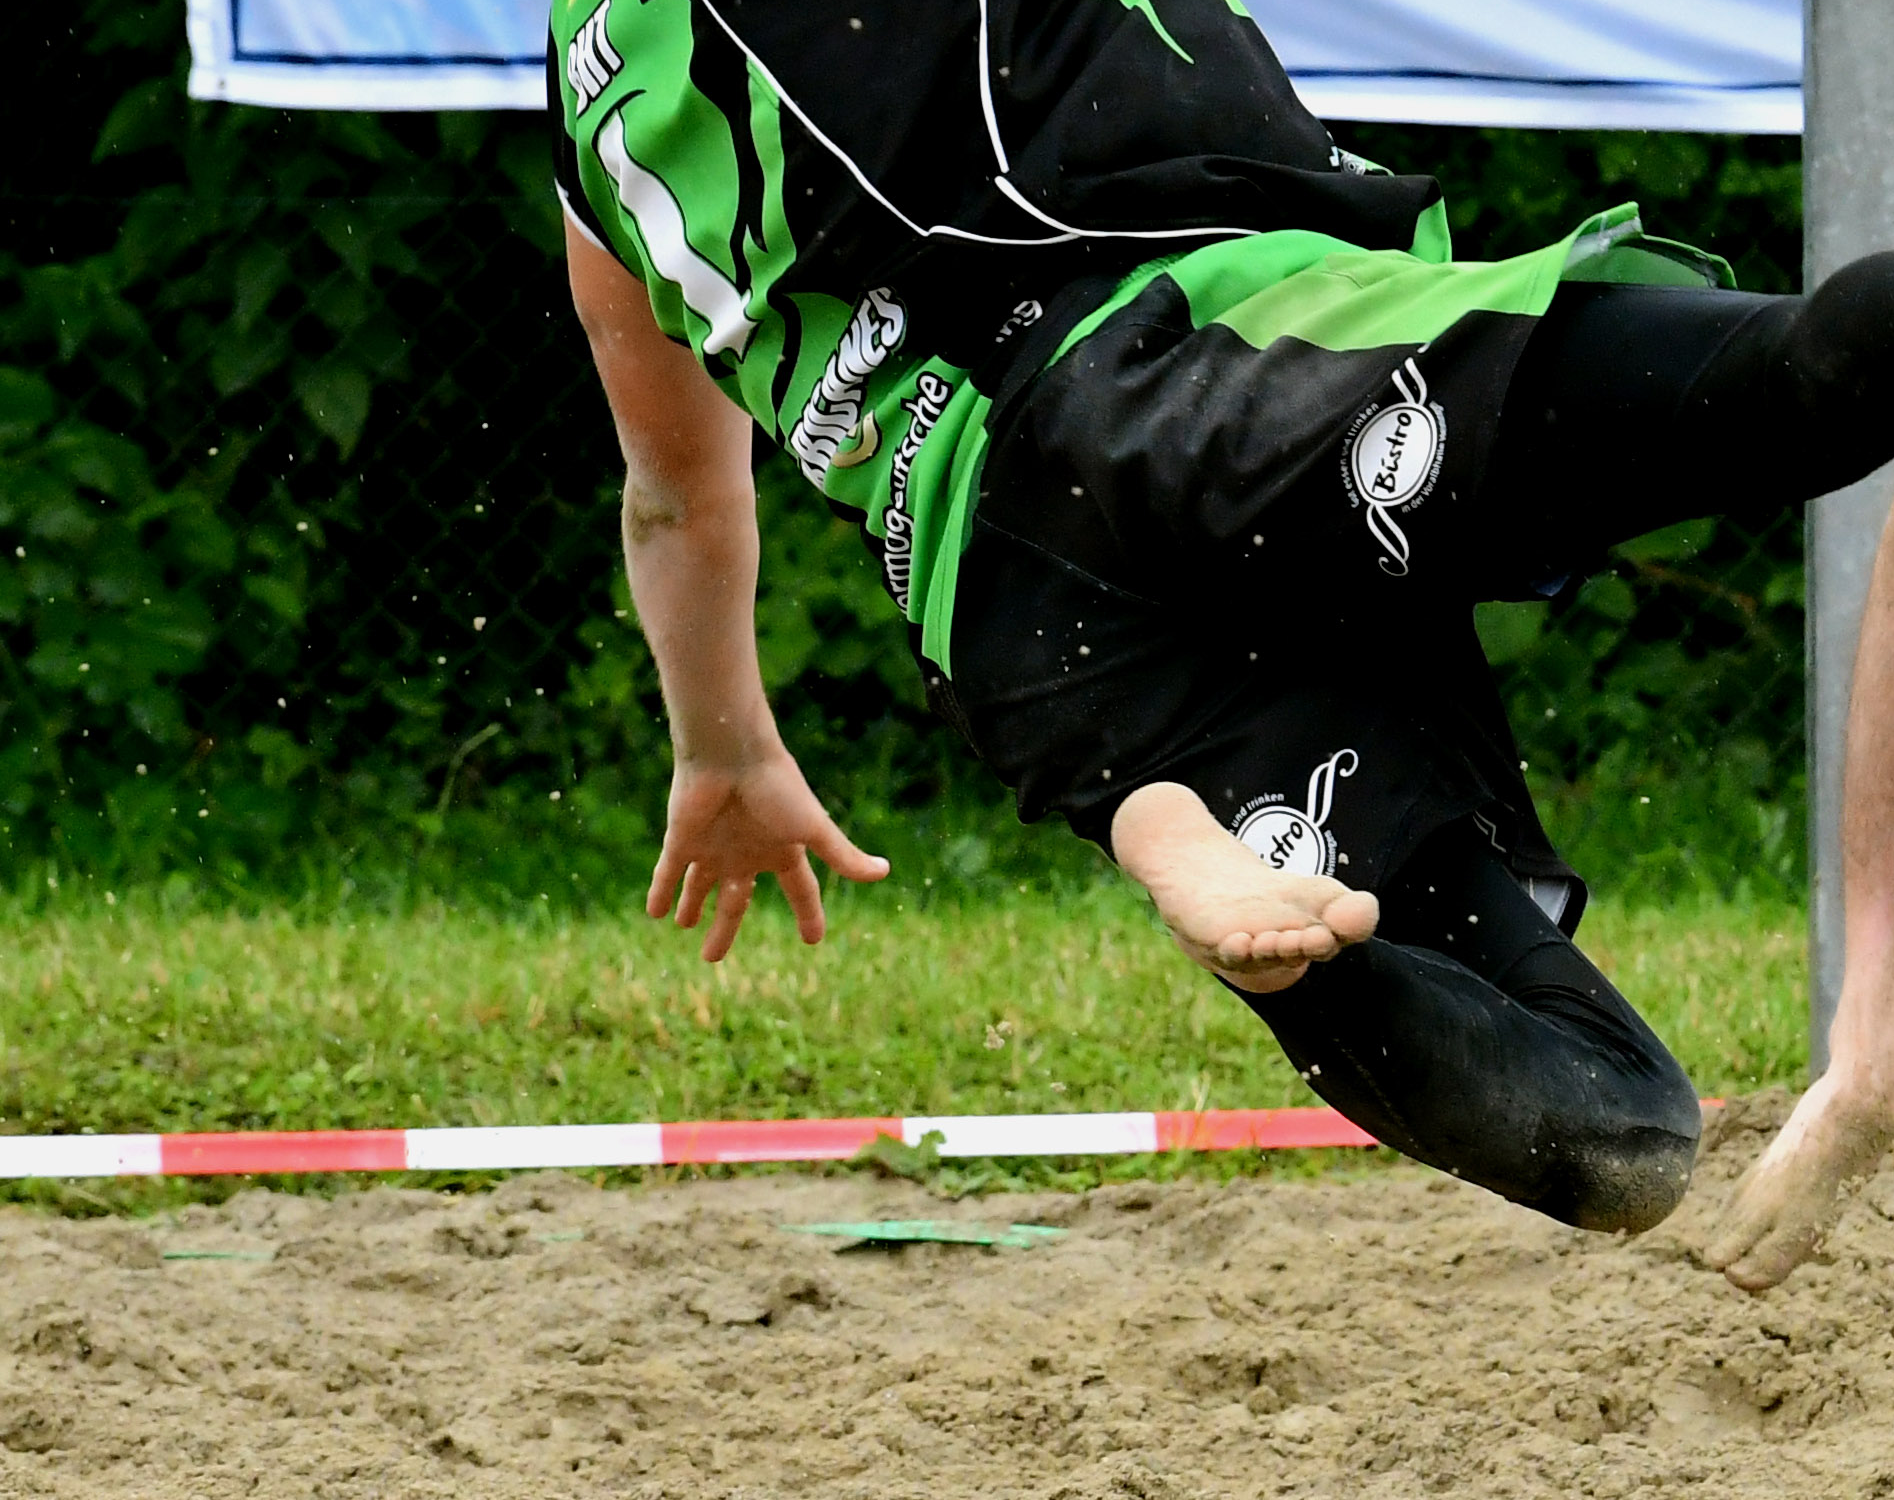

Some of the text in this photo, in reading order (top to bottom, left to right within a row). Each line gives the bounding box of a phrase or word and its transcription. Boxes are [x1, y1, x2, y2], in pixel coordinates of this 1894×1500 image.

[1347, 402, 1380, 437] trinken
[1371, 412, 1412, 494] Bistro
[1231, 791, 1286, 828] und trinken
